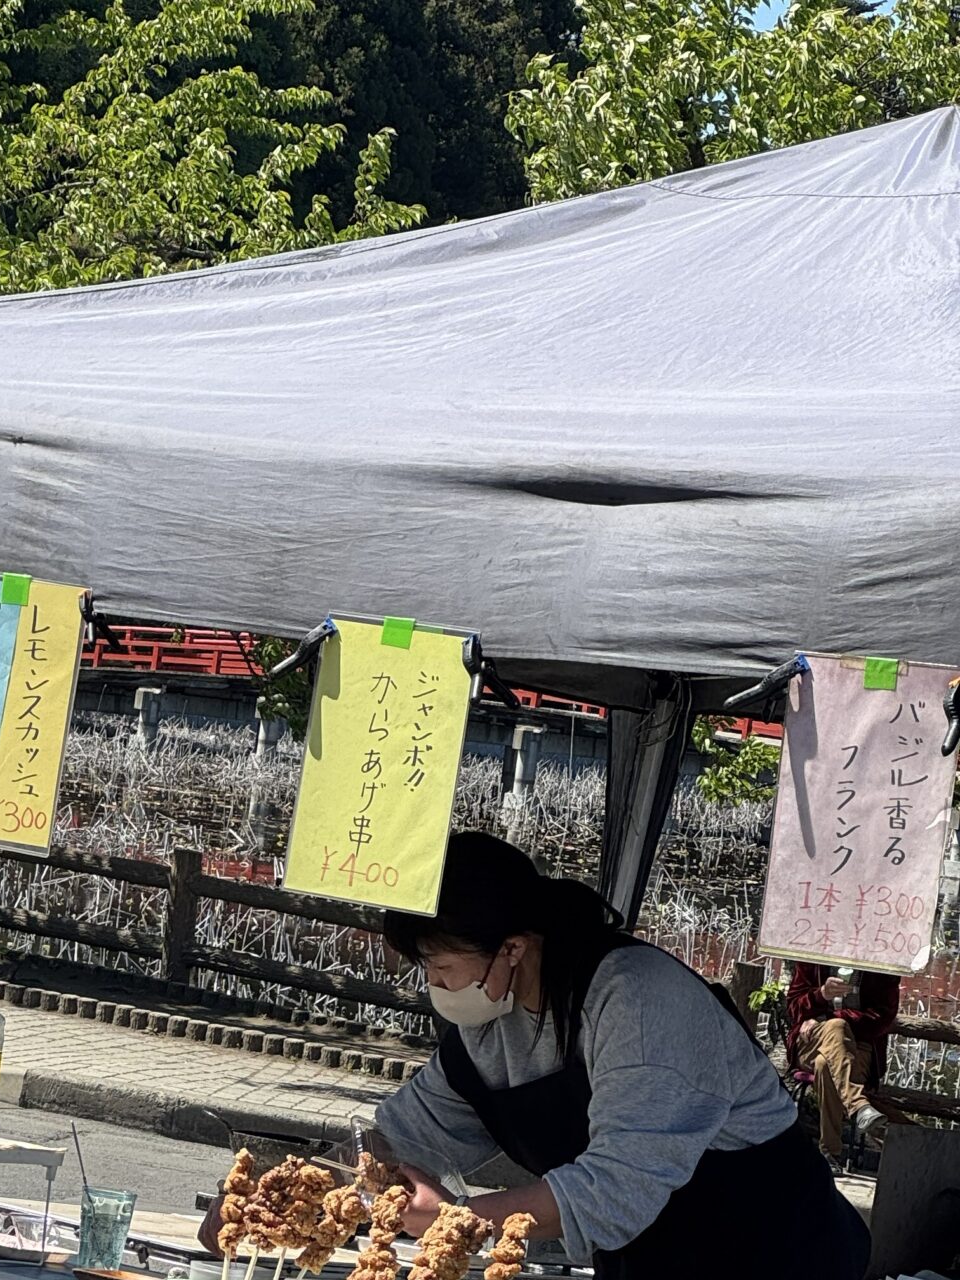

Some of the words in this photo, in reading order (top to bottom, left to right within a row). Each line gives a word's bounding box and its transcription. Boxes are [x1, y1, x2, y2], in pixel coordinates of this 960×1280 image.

[11, 604, 51, 797] レモンスカッシュ
[348, 671, 398, 857] からあげ串
[829, 745, 861, 876] フランク
[882, 701, 929, 866] バジル香る
[320, 845, 399, 888] ¥400
[797, 881, 841, 913] 1本
[855, 884, 925, 920] ¥300
[789, 918, 838, 950] 2本
[848, 922, 922, 955] ¥500
